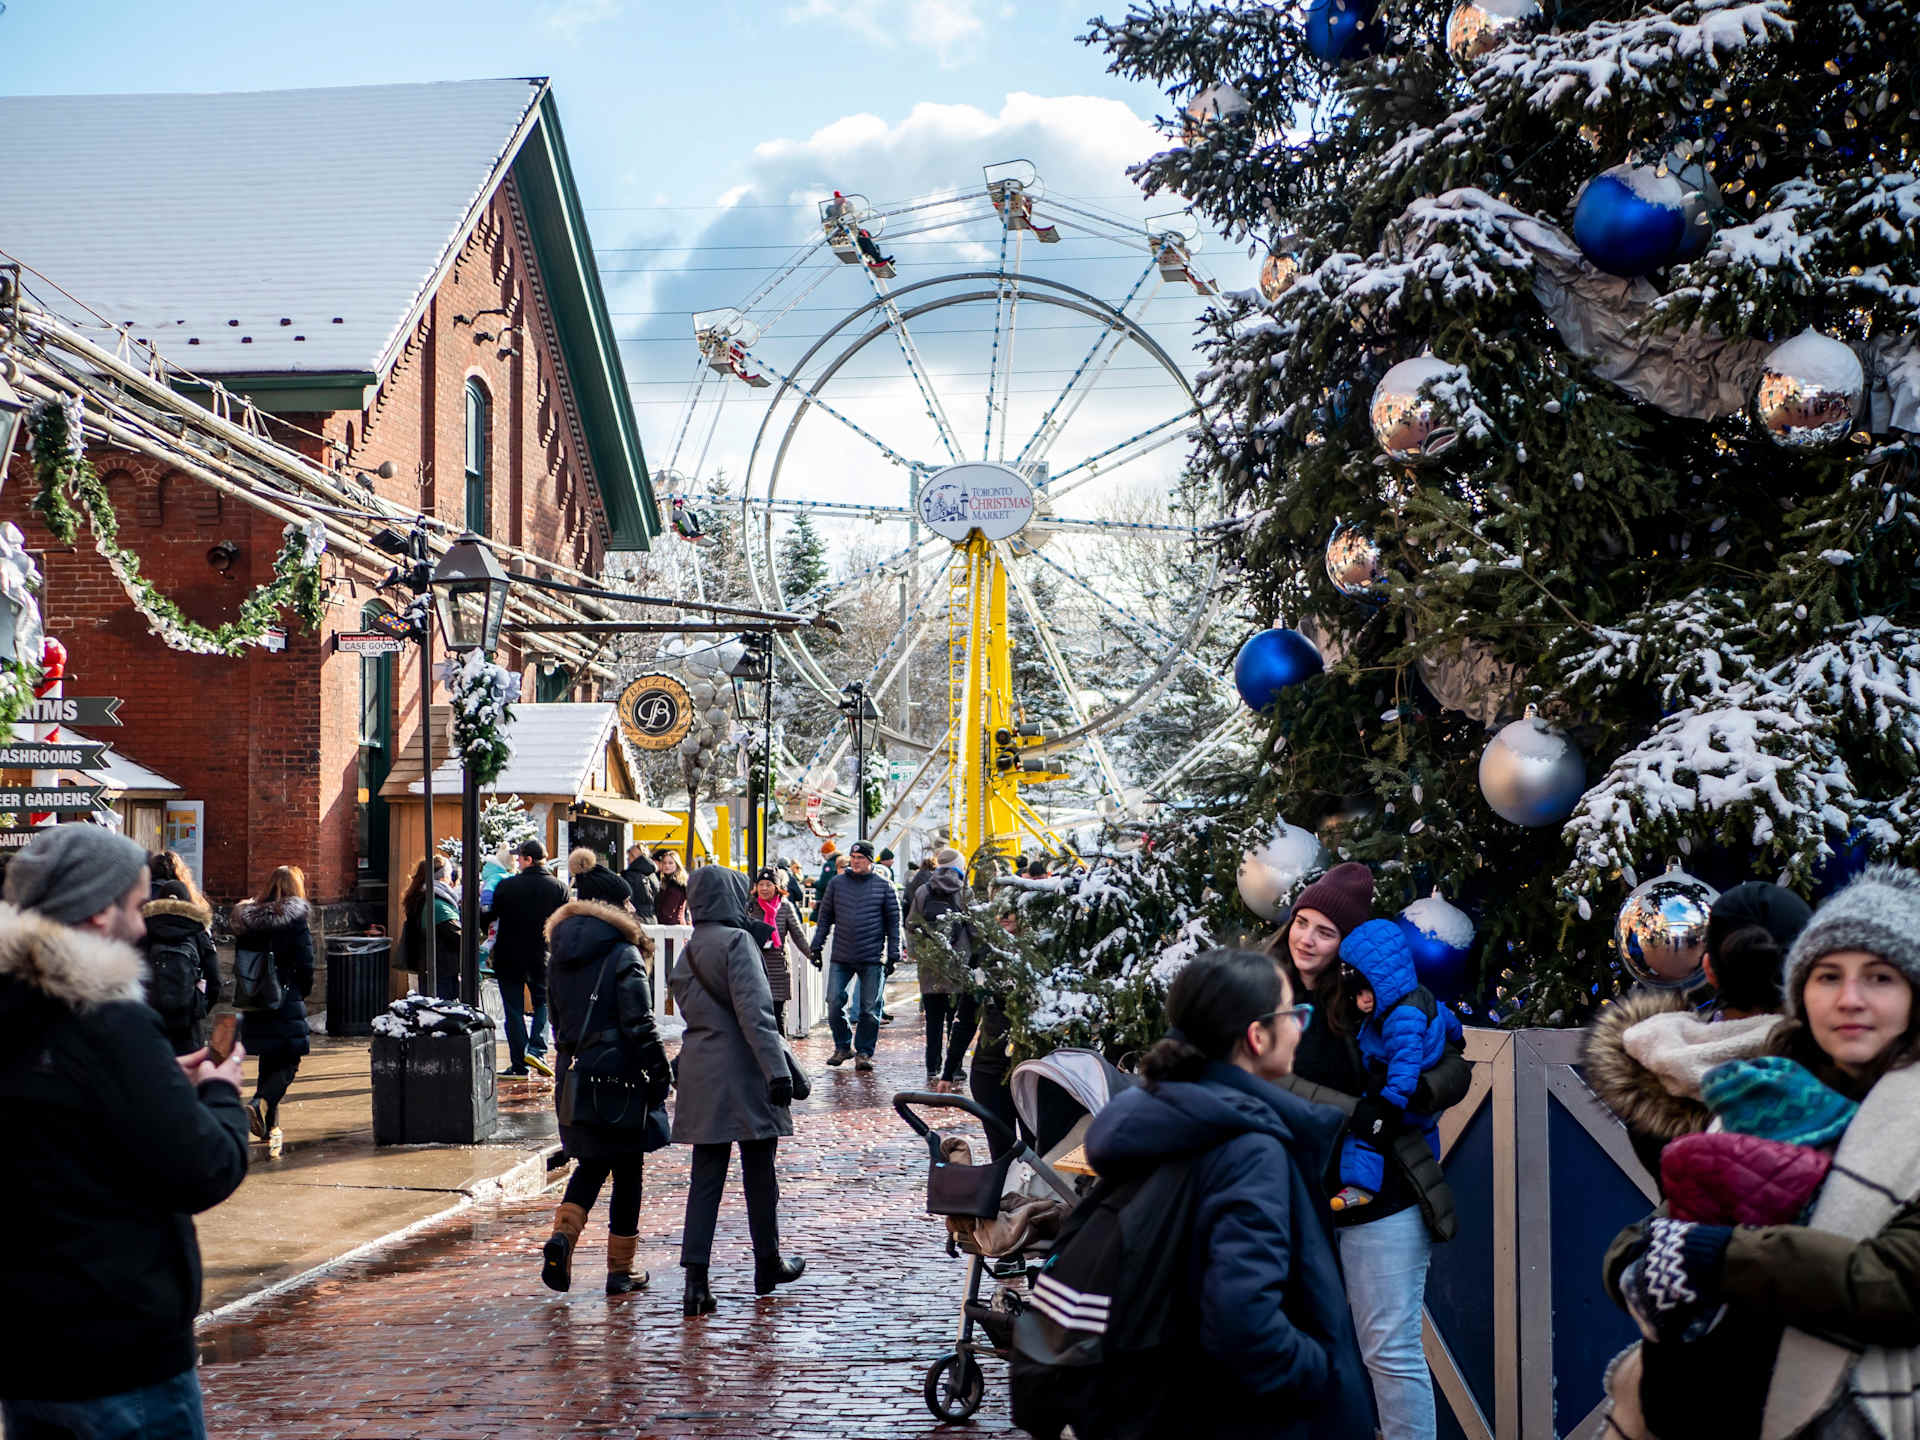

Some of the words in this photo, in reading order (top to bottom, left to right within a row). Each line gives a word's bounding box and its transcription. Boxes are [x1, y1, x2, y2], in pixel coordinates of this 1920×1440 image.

[971, 487, 1013, 496] TORONTO
[969, 496, 1032, 510] CHRISTMAS
[972, 510, 1009, 520] MARKET
[344, 642, 366, 650] CASE
[368, 642, 398, 650] GOODS
[17, 699, 78, 721] ATMS
[0, 749, 83, 764] ASHROOMS
[24, 792, 91, 807] GARDENS
